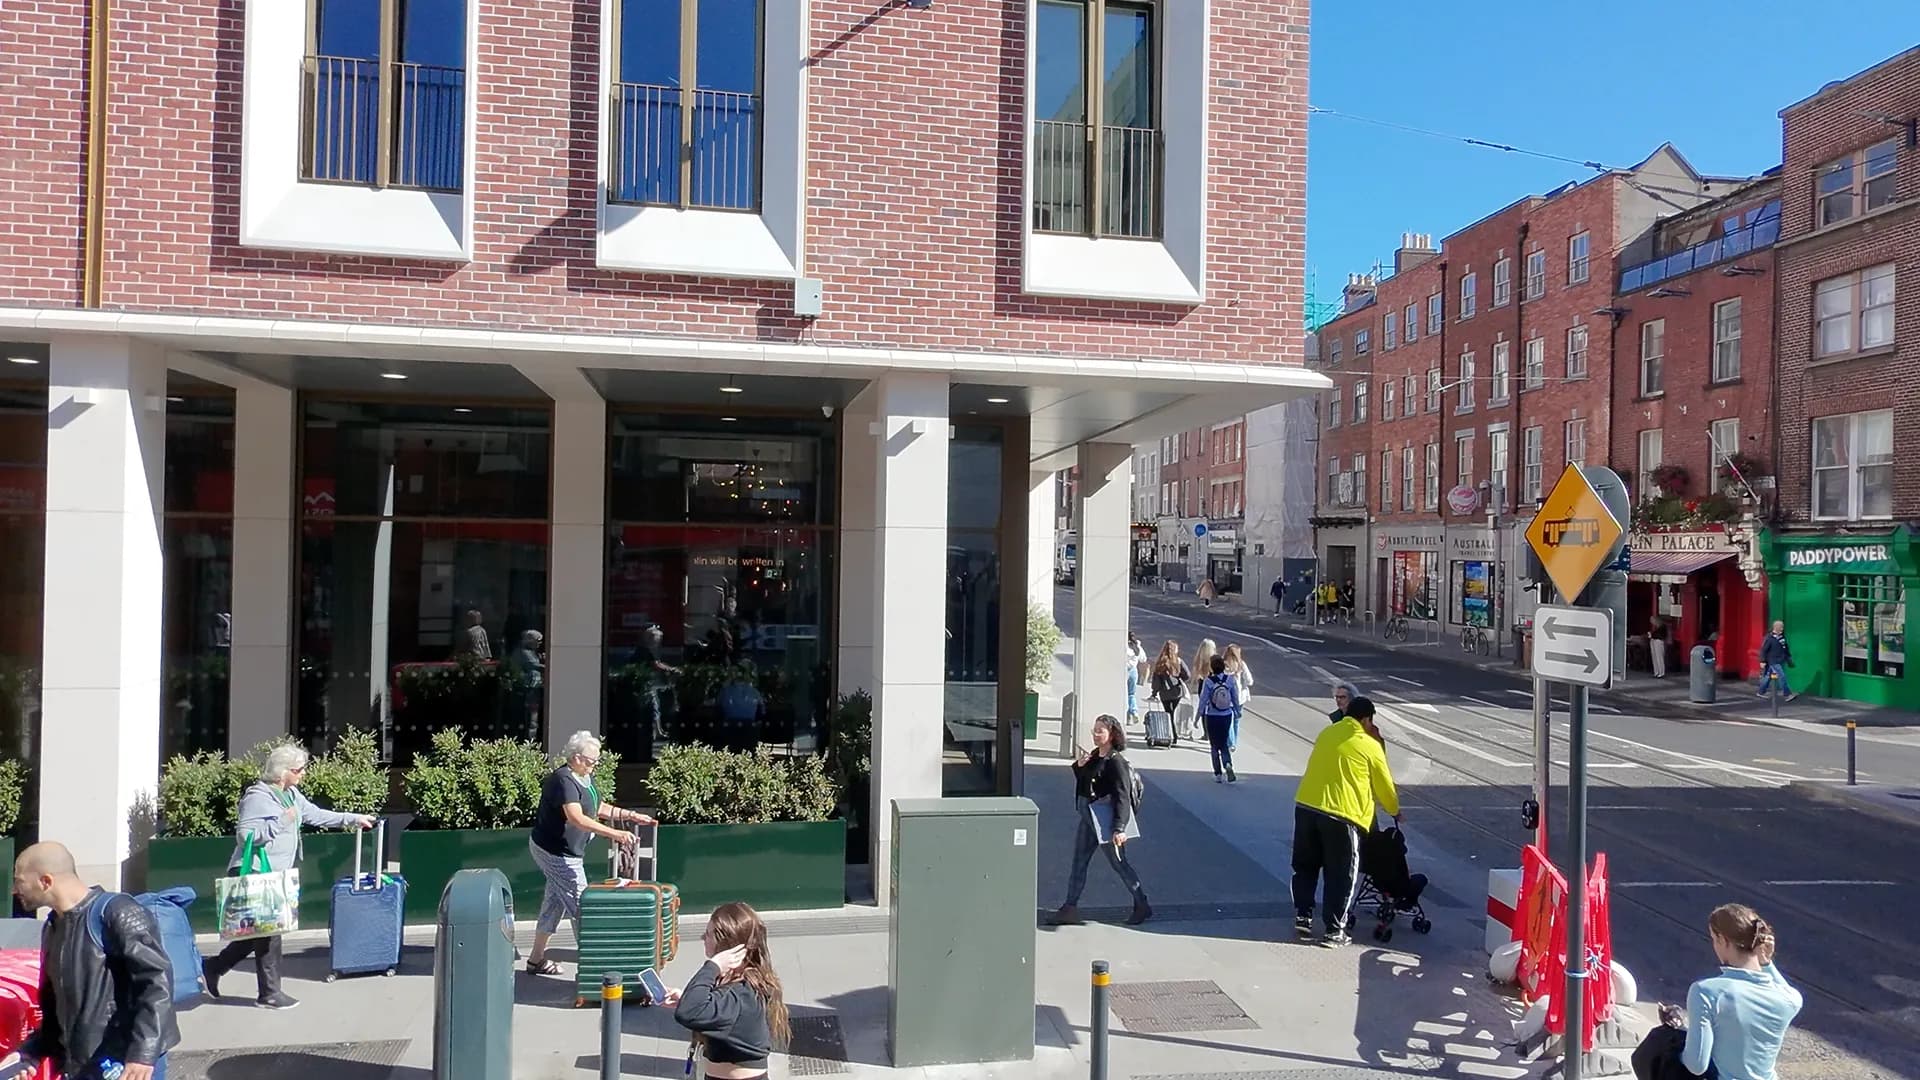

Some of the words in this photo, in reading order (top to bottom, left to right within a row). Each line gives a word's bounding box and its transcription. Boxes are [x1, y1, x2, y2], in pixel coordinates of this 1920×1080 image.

[1411, 535, 1437, 546] TRAVEL
[1454, 538, 1495, 549] AUSTRALI
[1662, 535, 1715, 550] PALACE
[711, 556, 725, 566] will
[1790, 545, 1888, 566] PADDYPOWER
